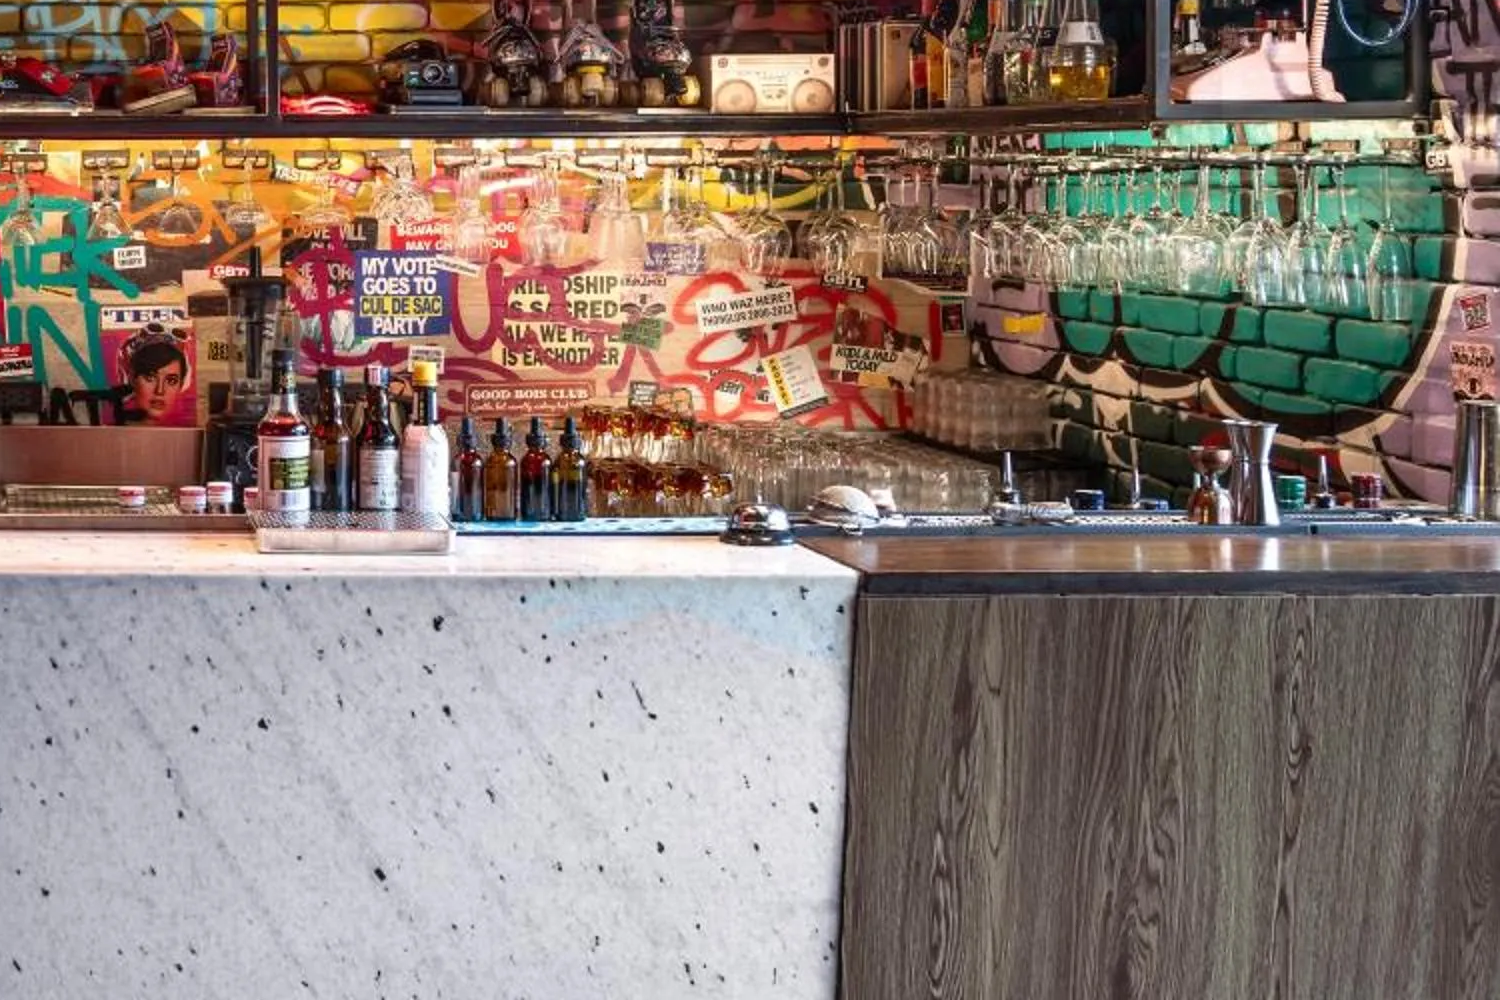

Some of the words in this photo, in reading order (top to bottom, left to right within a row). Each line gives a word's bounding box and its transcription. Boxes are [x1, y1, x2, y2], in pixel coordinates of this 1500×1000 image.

[361, 256, 388, 276] MY
[391, 256, 438, 276] VOTE
[362, 278, 412, 297] GOES
[414, 278, 437, 297] TO
[360, 297, 388, 316] CUL
[390, 298, 410, 316] DE
[412, 298, 443, 317] SAC
[701, 303, 727, 315] WHO
[756, 291, 792, 307] HERE?
[372, 318, 429, 335] PARTY
[471, 389, 512, 401] GOOD
